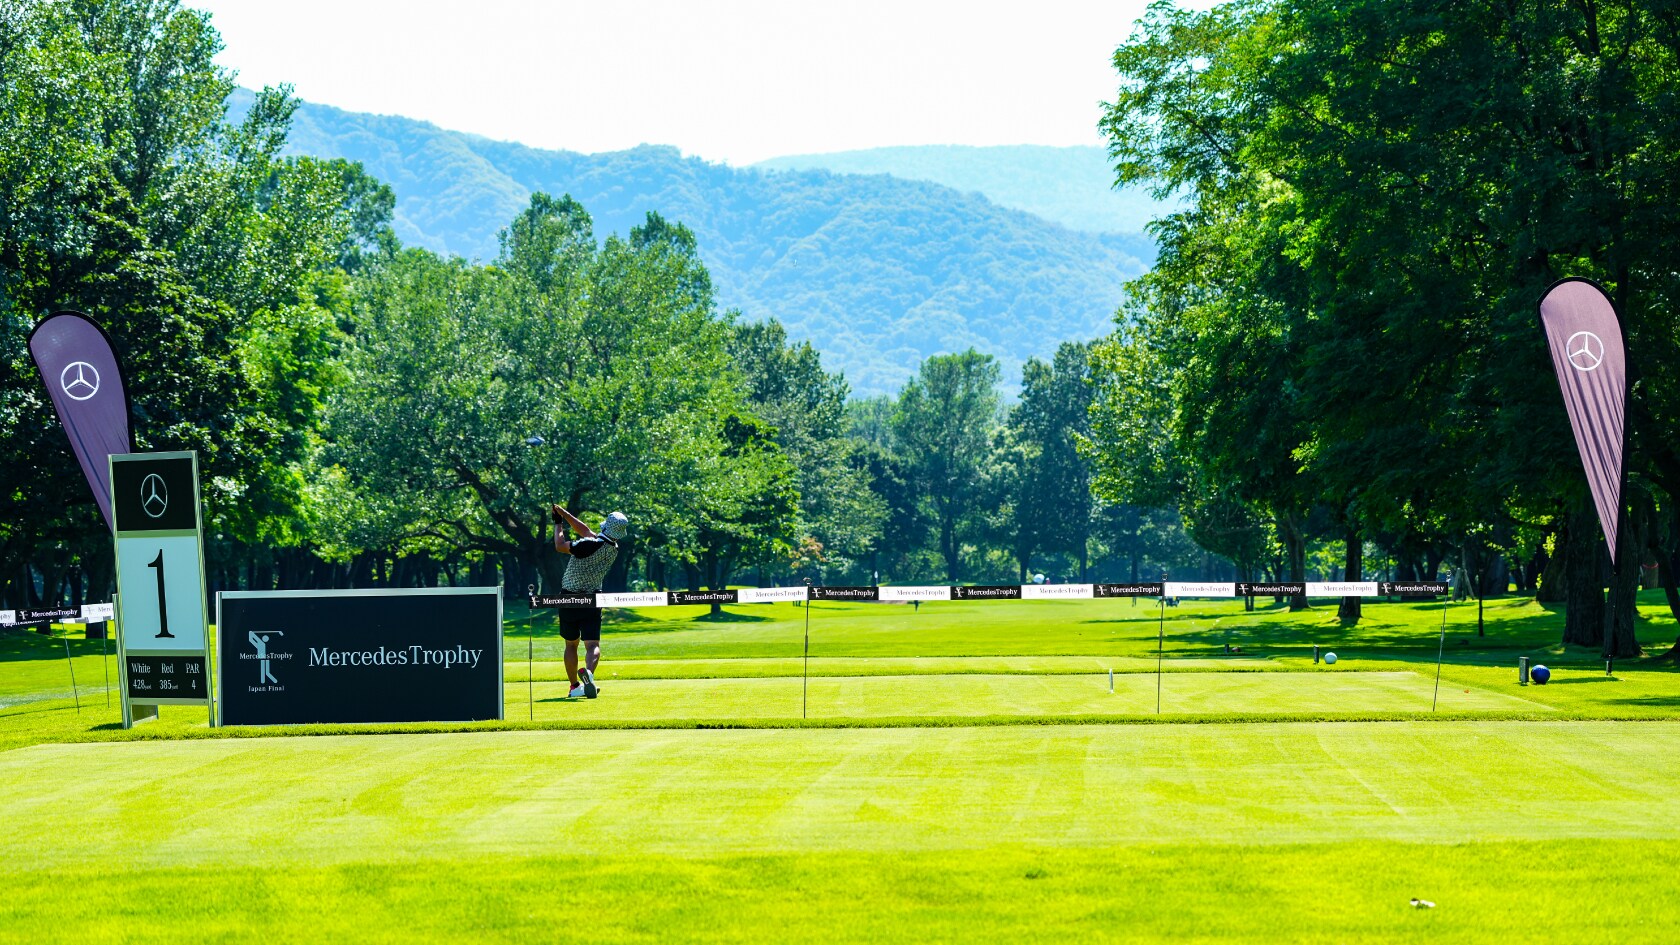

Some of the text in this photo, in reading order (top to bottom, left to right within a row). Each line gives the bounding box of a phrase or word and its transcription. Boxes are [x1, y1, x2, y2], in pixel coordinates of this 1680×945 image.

[148, 549, 175, 638] 1
[825, 589, 875, 597] MercedesTrophy
[967, 588, 1018, 596] MercedesTrophy
[1110, 585, 1161, 594] MercedesTrophy
[1252, 585, 1302, 594] MercedesTrophy
[1394, 585, 1444, 594] MercedesTrophy
[542, 597, 592, 605] MercedesTrophy
[684, 593, 734, 601] MercedesTrophy
[239, 652, 293, 661] MercesTrophy
[308, 645, 483, 669] MercedesTrophy
[131, 662, 200, 674] White Red PAR
[191, 679, 197, 690] 4
[248, 685, 266, 693] Japan
